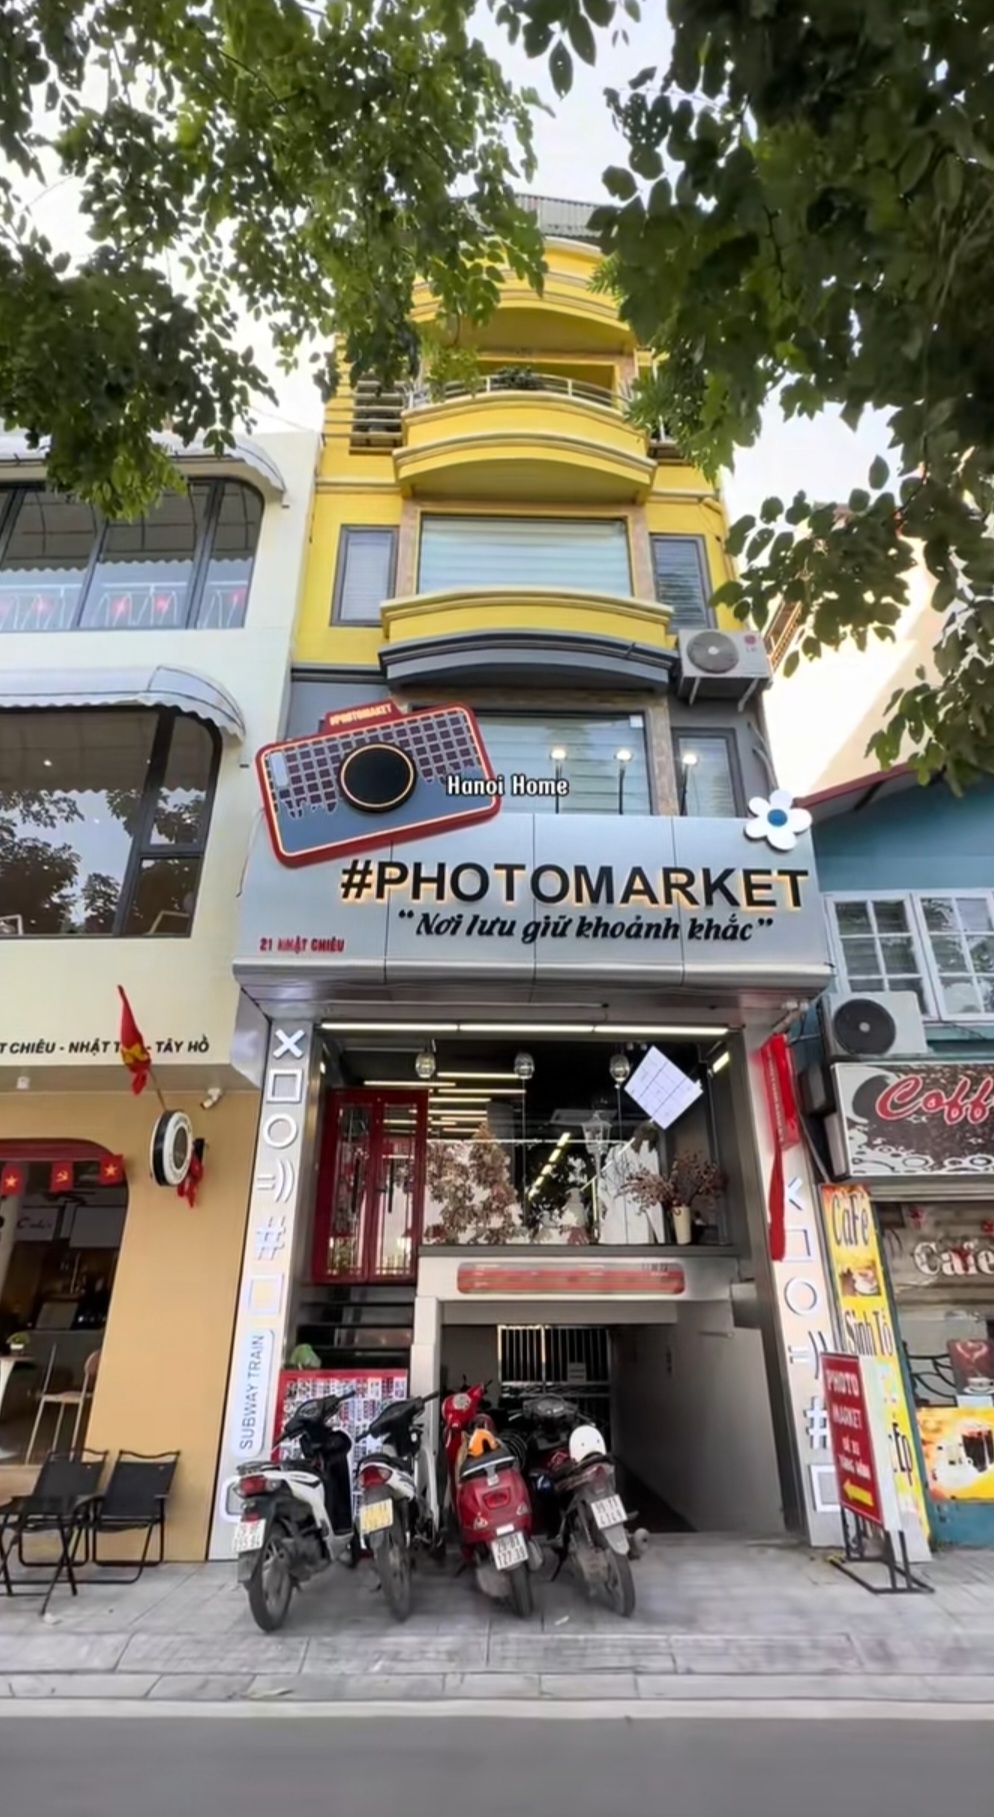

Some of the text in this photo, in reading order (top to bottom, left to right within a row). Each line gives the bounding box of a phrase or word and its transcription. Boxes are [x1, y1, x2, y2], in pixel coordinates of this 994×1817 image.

[340, 858, 810, 910] #PHOTOMARKET
[465, 914, 516, 937] lưu
[522, 913, 574, 944] giữ
[575, 914, 680, 940] khoảnh
[259, 936, 273, 952] 21
[68, 1037, 111, 1057] NHẬT
[155, 1038, 184, 1053] TÂY
[187, 1033, 211, 1054] HỒ
[875, 1073, 994, 1125] Coff
[239, 1335, 265, 1450] SUBWAY TRAIN
[826, 1368, 860, 1397] PHOTO
[832, 1402, 863, 1430] MARKET
